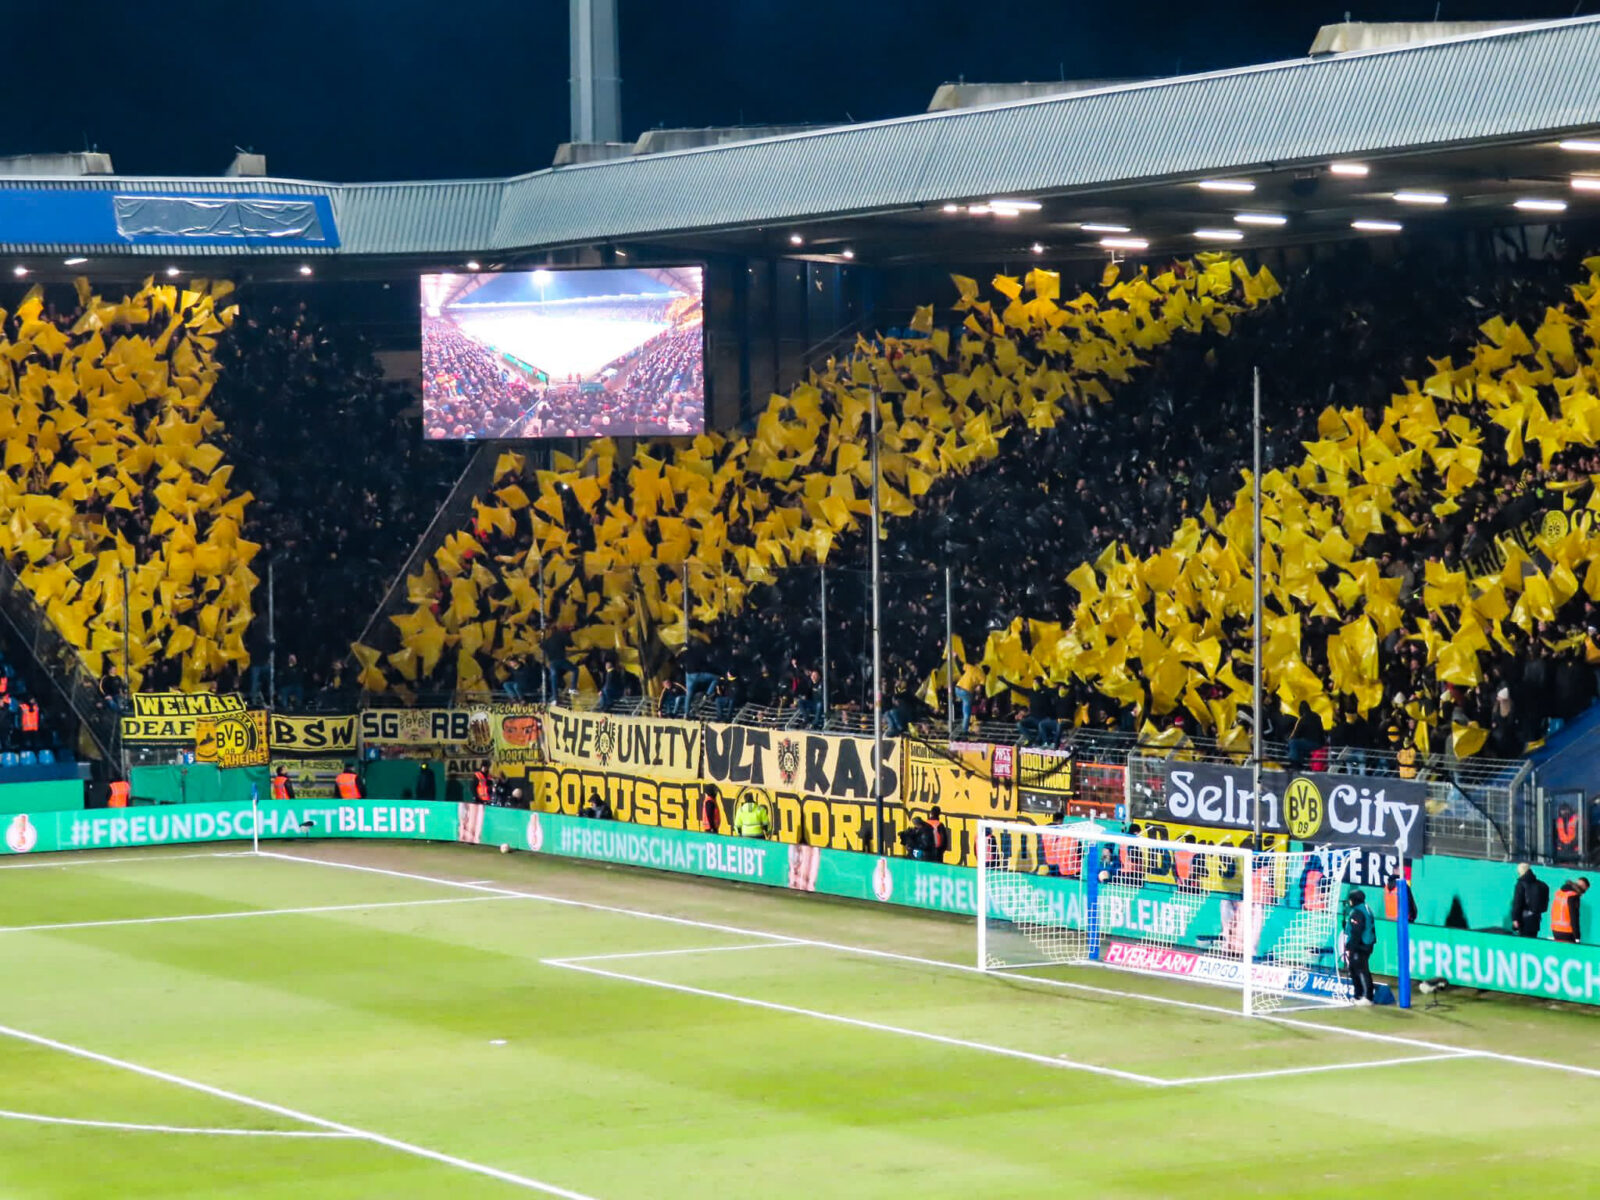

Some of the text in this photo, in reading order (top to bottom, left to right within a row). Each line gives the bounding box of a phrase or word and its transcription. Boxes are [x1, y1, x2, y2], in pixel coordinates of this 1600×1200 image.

[136, 695, 242, 714] WEIMAR
[124, 721, 195, 736] DEAF
[216, 724, 245, 748] BVB
[273, 717, 354, 747] BSW
[362, 712, 399, 738] SG
[550, 712, 698, 769] THE UNITY
[704, 724, 897, 800] ULT RAS
[1167, 770, 1280, 828] Selm
[1326, 784, 1417, 853] City
[1286, 784, 1316, 823] BVB
[560, 825, 766, 878] #FREUNDSCHAFTBLEIBT
[1106, 945, 1194, 974] FLYERALARM
